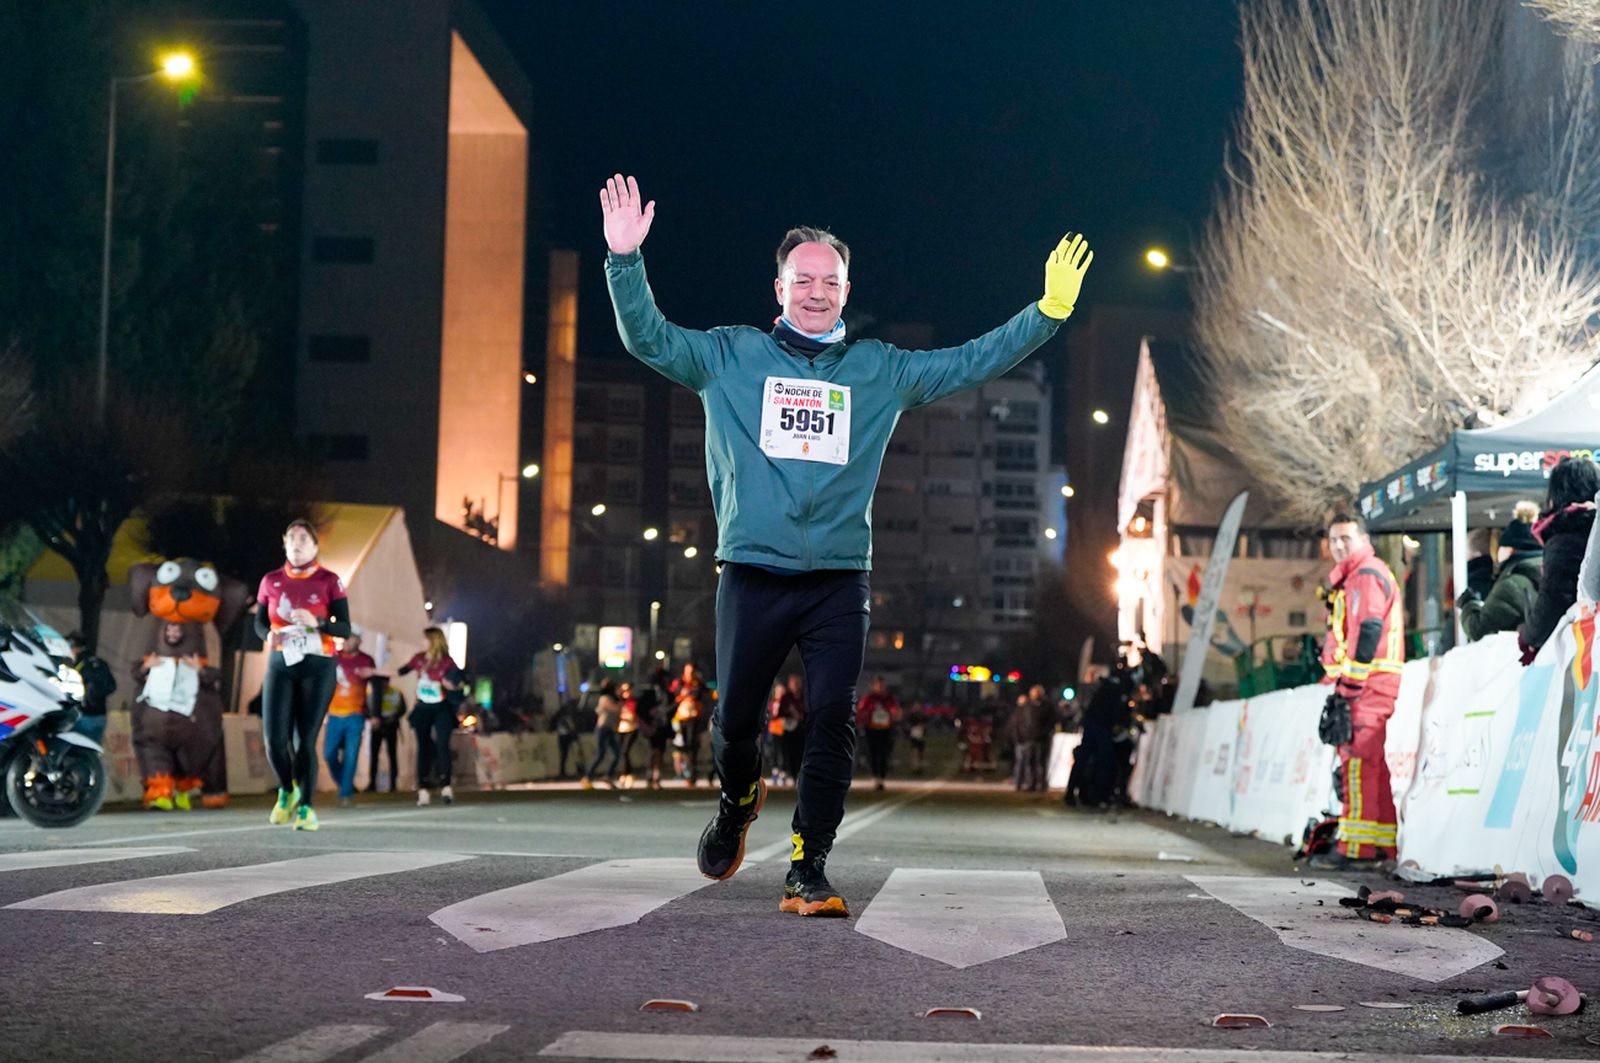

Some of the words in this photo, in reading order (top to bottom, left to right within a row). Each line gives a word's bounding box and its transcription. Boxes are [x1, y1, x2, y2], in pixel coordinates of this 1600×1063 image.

[784, 387, 811, 397] NOCHE
[812, 390, 823, 398] DE
[773, 396, 791, 405] SAN
[780, 407, 835, 435] 5951
